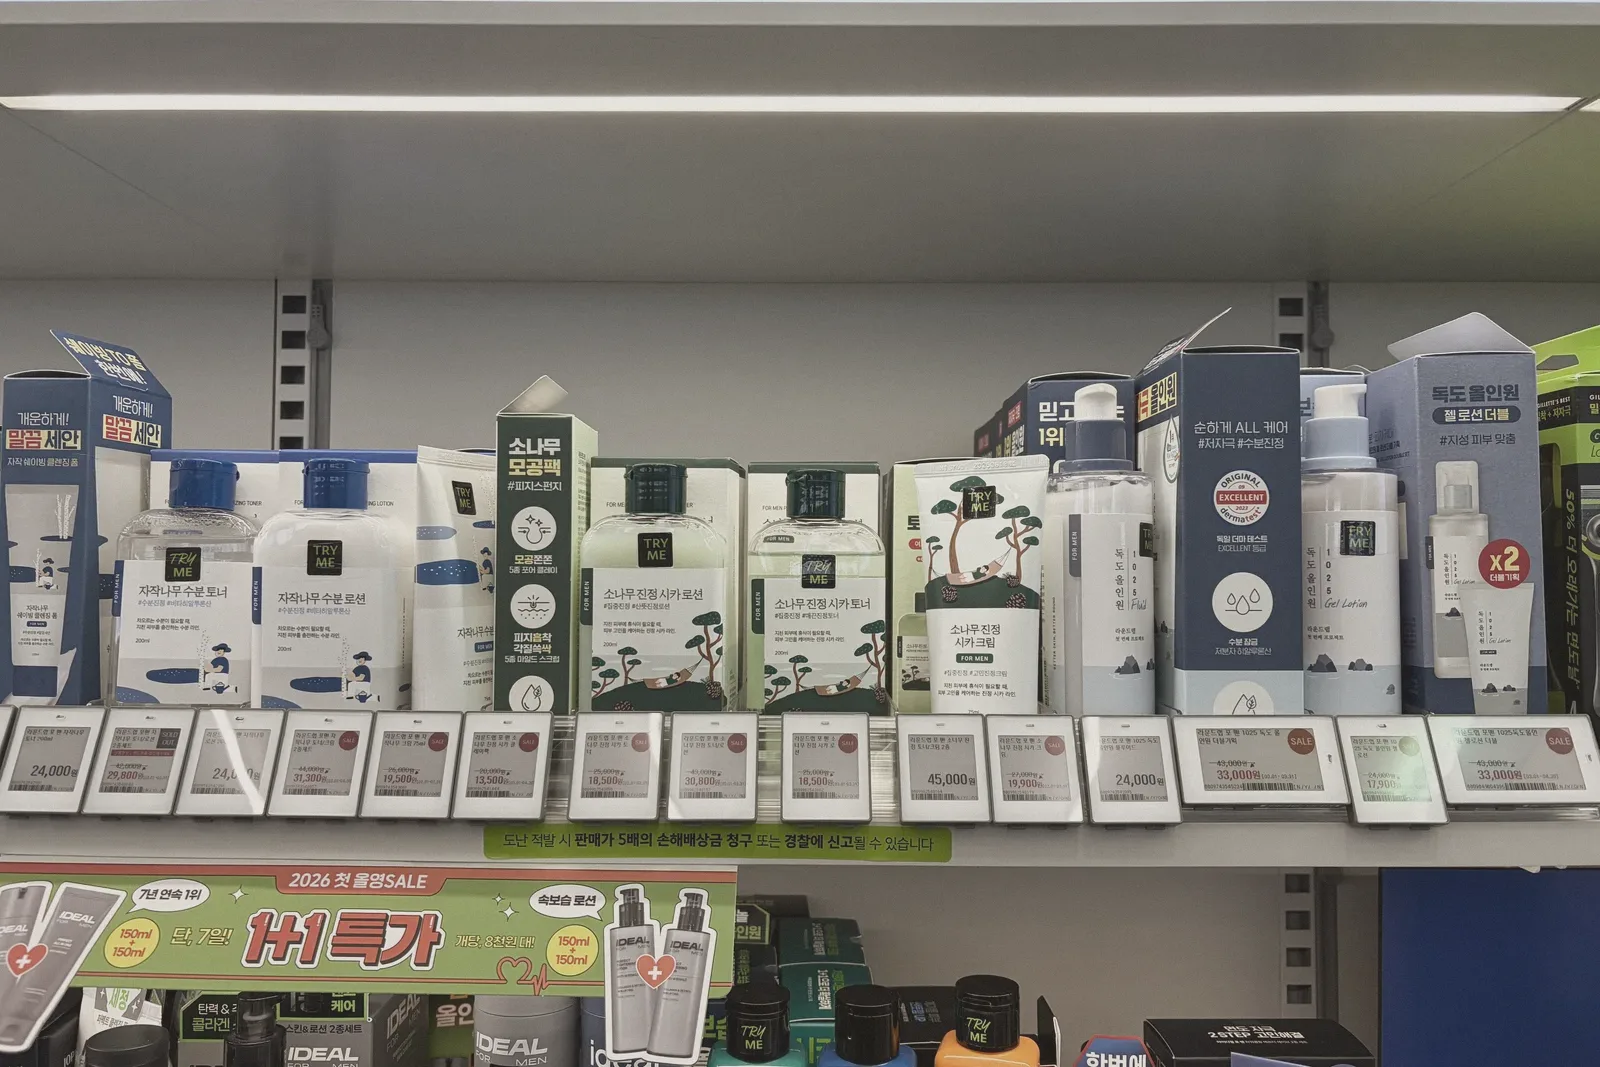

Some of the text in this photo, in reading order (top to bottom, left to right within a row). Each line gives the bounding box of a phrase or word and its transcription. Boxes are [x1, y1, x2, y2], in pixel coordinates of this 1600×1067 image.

[1151, 374, 1176, 414] 올인원
[1432, 384, 1519, 403] 독도 올인원
[113, 396, 153, 418] 개운하게!
[1039, 401, 1075, 422] 믿고
[18, 412, 69, 426] 개운하게!
[1444, 408, 1509, 421] 젤 로션 더블
[105, 416, 160, 447] 말끔 세안
[1194, 421, 1288, 434] 순하게 ALL 케어
[8, 430, 78, 450] 말끔 세안
[1039, 427, 1064, 446] 1위
[1439, 433, 1516, 446] #지성 피부 맞춤
[508, 438, 561, 456] 소나무
[1198, 438, 1284, 449] #저자극 #수분진정
[7, 458, 23, 467] 자작
[23, 458, 46, 467] 쉐이빙
[47, 458, 70, 467] 클렌징
[509, 459, 561, 477] 모공팩
[507, 481, 562, 492] #피지스펀지
[1221, 473, 1261, 488] ORIGINAL
[456, 486, 471, 497] TRY
[968, 490, 992, 502] TRY
[459, 499, 472, 508] ME
[971, 502, 990, 512] ME
[1565, 488, 1576, 529] 50%
[1220, 508, 1261, 523] dermatest
[1349, 526, 1372, 536] TRY
[643, 538, 668, 548] TRY
[1350, 538, 1369, 548] ME
[1566, 535, 1577, 553] 더
[313, 545, 338, 556] TRY
[647, 550, 666, 560] ME
[170, 552, 197, 566] TRY
[316, 557, 335, 568] ME
[514, 555, 552, 564] 모공쫀쫀
[1490, 546, 1520, 572] x2
[173, 568, 192, 577] ME
[810, 575, 828, 585] ME
[139, 585, 227, 598] 자작나무 수분 토너
[604, 588, 703, 600] 소나무 진정 시카 로션
[1566, 556, 1580, 625] 오래가는
[278, 592, 366, 605] 자작나무 수분 로션
[775, 598, 871, 610] 소나무 진정 시카 토너
[1131, 598, 1147, 610] Fluid
[1324, 598, 1368, 609] Gel Lotion
[457, 626, 484, 638] 자작나무
[950, 624, 1000, 635] 소나무 진정
[514, 633, 552, 642] 피지흡착
[955, 637, 995, 648] 시카 크림
[1214, 647, 1236, 655] 저분자
[30, 764, 79, 778] 24,000원
[1217, 770, 1260, 781] 33,000원
[1477, 770, 1522, 781] 33,000원
[293, 773, 326, 783] 31,300원
[383, 774, 417, 784] 19,500원
[475, 776, 509, 785] 13,500원
[589, 776, 623, 785] 18,500원
[799, 777, 833, 786] 18,500원
[928, 774, 975, 786] 45,000원
[1008, 779, 1043, 788] 19,900원
[1116, 774, 1164, 787] 24,000원
[503, 833, 934, 852] 도난 적발 시 판매가 5배의 손해배상금 청구 또는 경찰에 신고될 수 있습니다
[288, 872, 428, 889] 2026 첫 올영SALE
[138, 889, 201, 900] 7년 연속 1위
[538, 894, 596, 906] 속보습 로션
[58, 911, 95, 924] IDEAL
[119, 929, 152, 939] 150ml
[170, 927, 234, 946] 단, 7일!
[245, 911, 442, 966] 1+1 특가
[455, 935, 536, 949] 개당, 8천원 대!
[559, 936, 590, 946] 150ml
[616, 937, 650, 947] IDEAL
[670, 941, 703, 950] IDEAL
[112, 947, 146, 958] 150ml
[556, 955, 588, 965] 150ml
[198, 1004, 230, 1014] 탄력 &
[330, 1000, 356, 1013] 케어
[386, 994, 421, 1039] IDEAL
[192, 1018, 230, 1032] 콜라겐
[286, 1024, 363, 1034] 스킨&로션 2종세트
[966, 1016, 992, 1032] TRY
[741, 1025, 766, 1040] TRY
[969, 1032, 987, 1044] ME
[476, 1032, 548, 1056] IDEAL
[745, 1040, 763, 1049] ME
[288, 1047, 359, 1062] IDEAL
[476, 1052, 547, 1066] FOR MEN
